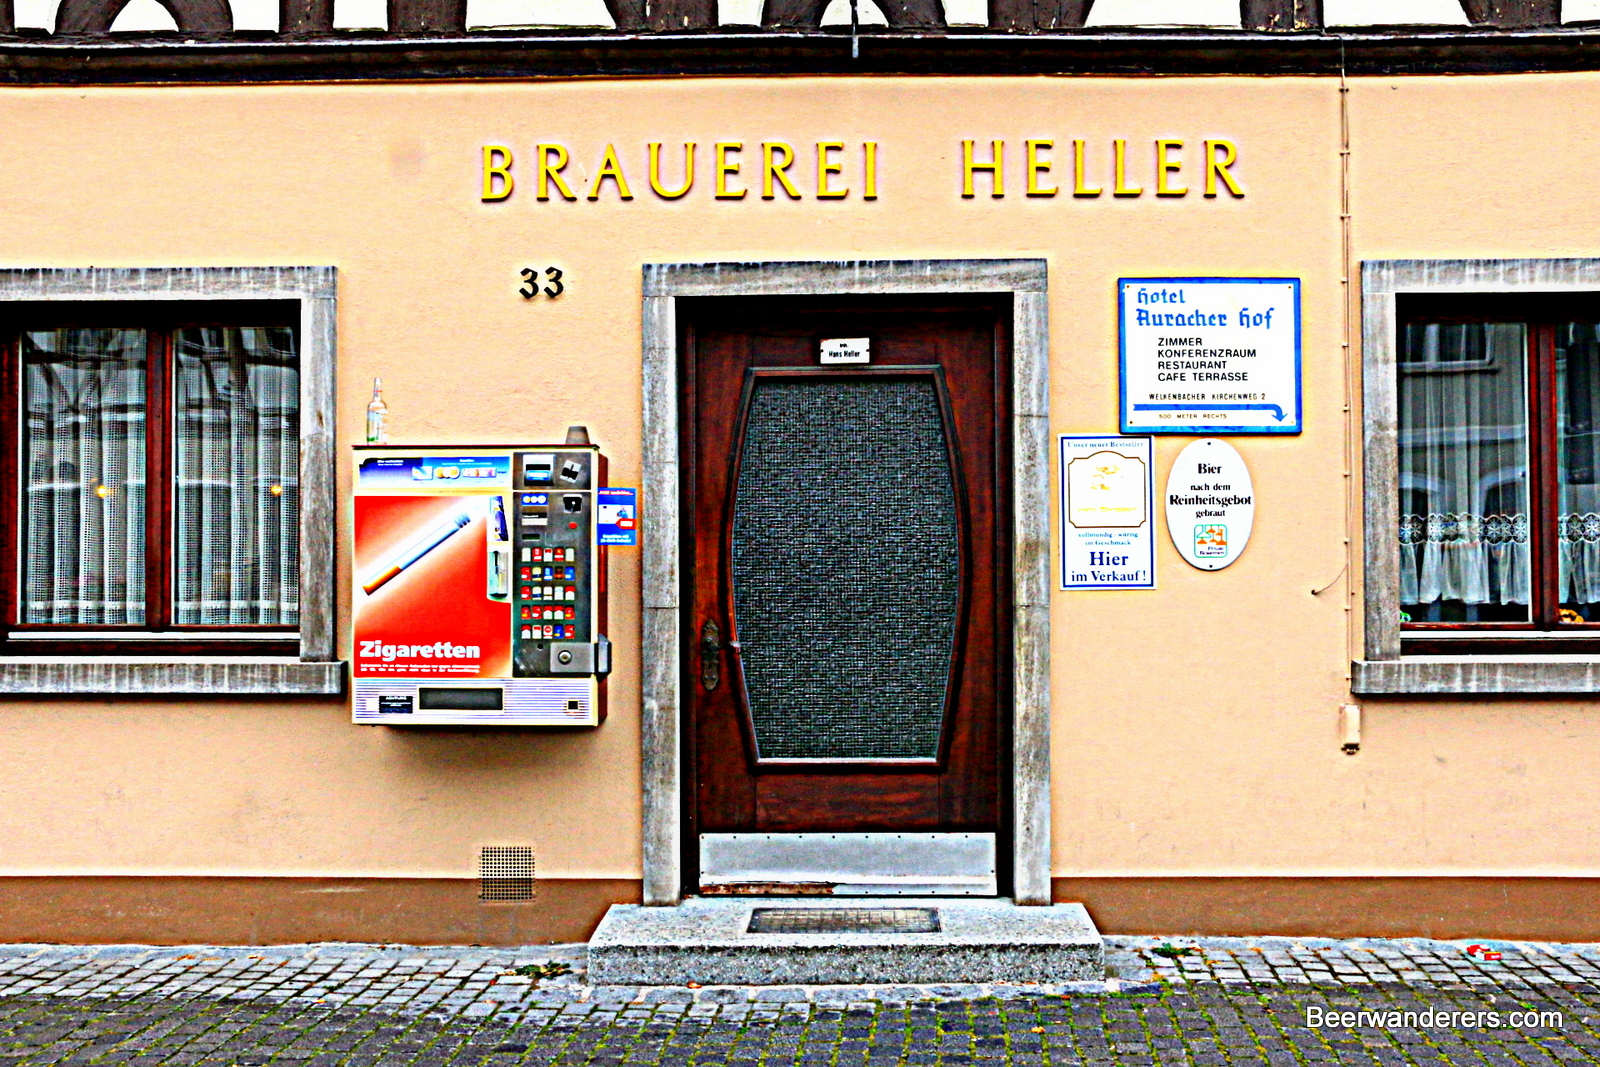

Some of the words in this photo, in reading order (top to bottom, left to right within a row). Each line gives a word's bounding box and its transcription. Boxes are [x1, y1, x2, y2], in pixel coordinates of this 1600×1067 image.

[481, 142, 879, 202] BRAUEREI
[961, 139, 1245, 199] HELLER
[518, 266, 565, 299] 33
[1137, 287, 1187, 306] Hotel
[1135, 308, 1228, 327] Auracher
[1238, 306, 1276, 330] Hof
[1157, 337, 1203, 347] ZIMMER
[1157, 348, 1257, 359] KONFERENZRAUM
[1157, 360, 1228, 370] RESTAURANT
[1157, 372, 1187, 382] CAFE
[1192, 371, 1249, 382] TERRASSE
[1148, 392, 1206, 401] WELKENBACHER
[1211, 392, 1258, 401] KIRCHENWEG
[1261, 392, 1266, 401] 2
[1197, 462, 1223, 475] Bier
[1190, 482, 1210, 491] nach
[1212, 482, 1231, 491] dem
[1169, 493, 1252, 507] Reinheitsgebot
[1195, 508, 1226, 519] gebraut
[1089, 551, 1130, 566] Hier
[1071, 570, 1088, 582] im
[359, 640, 480, 662] Zigaretten
